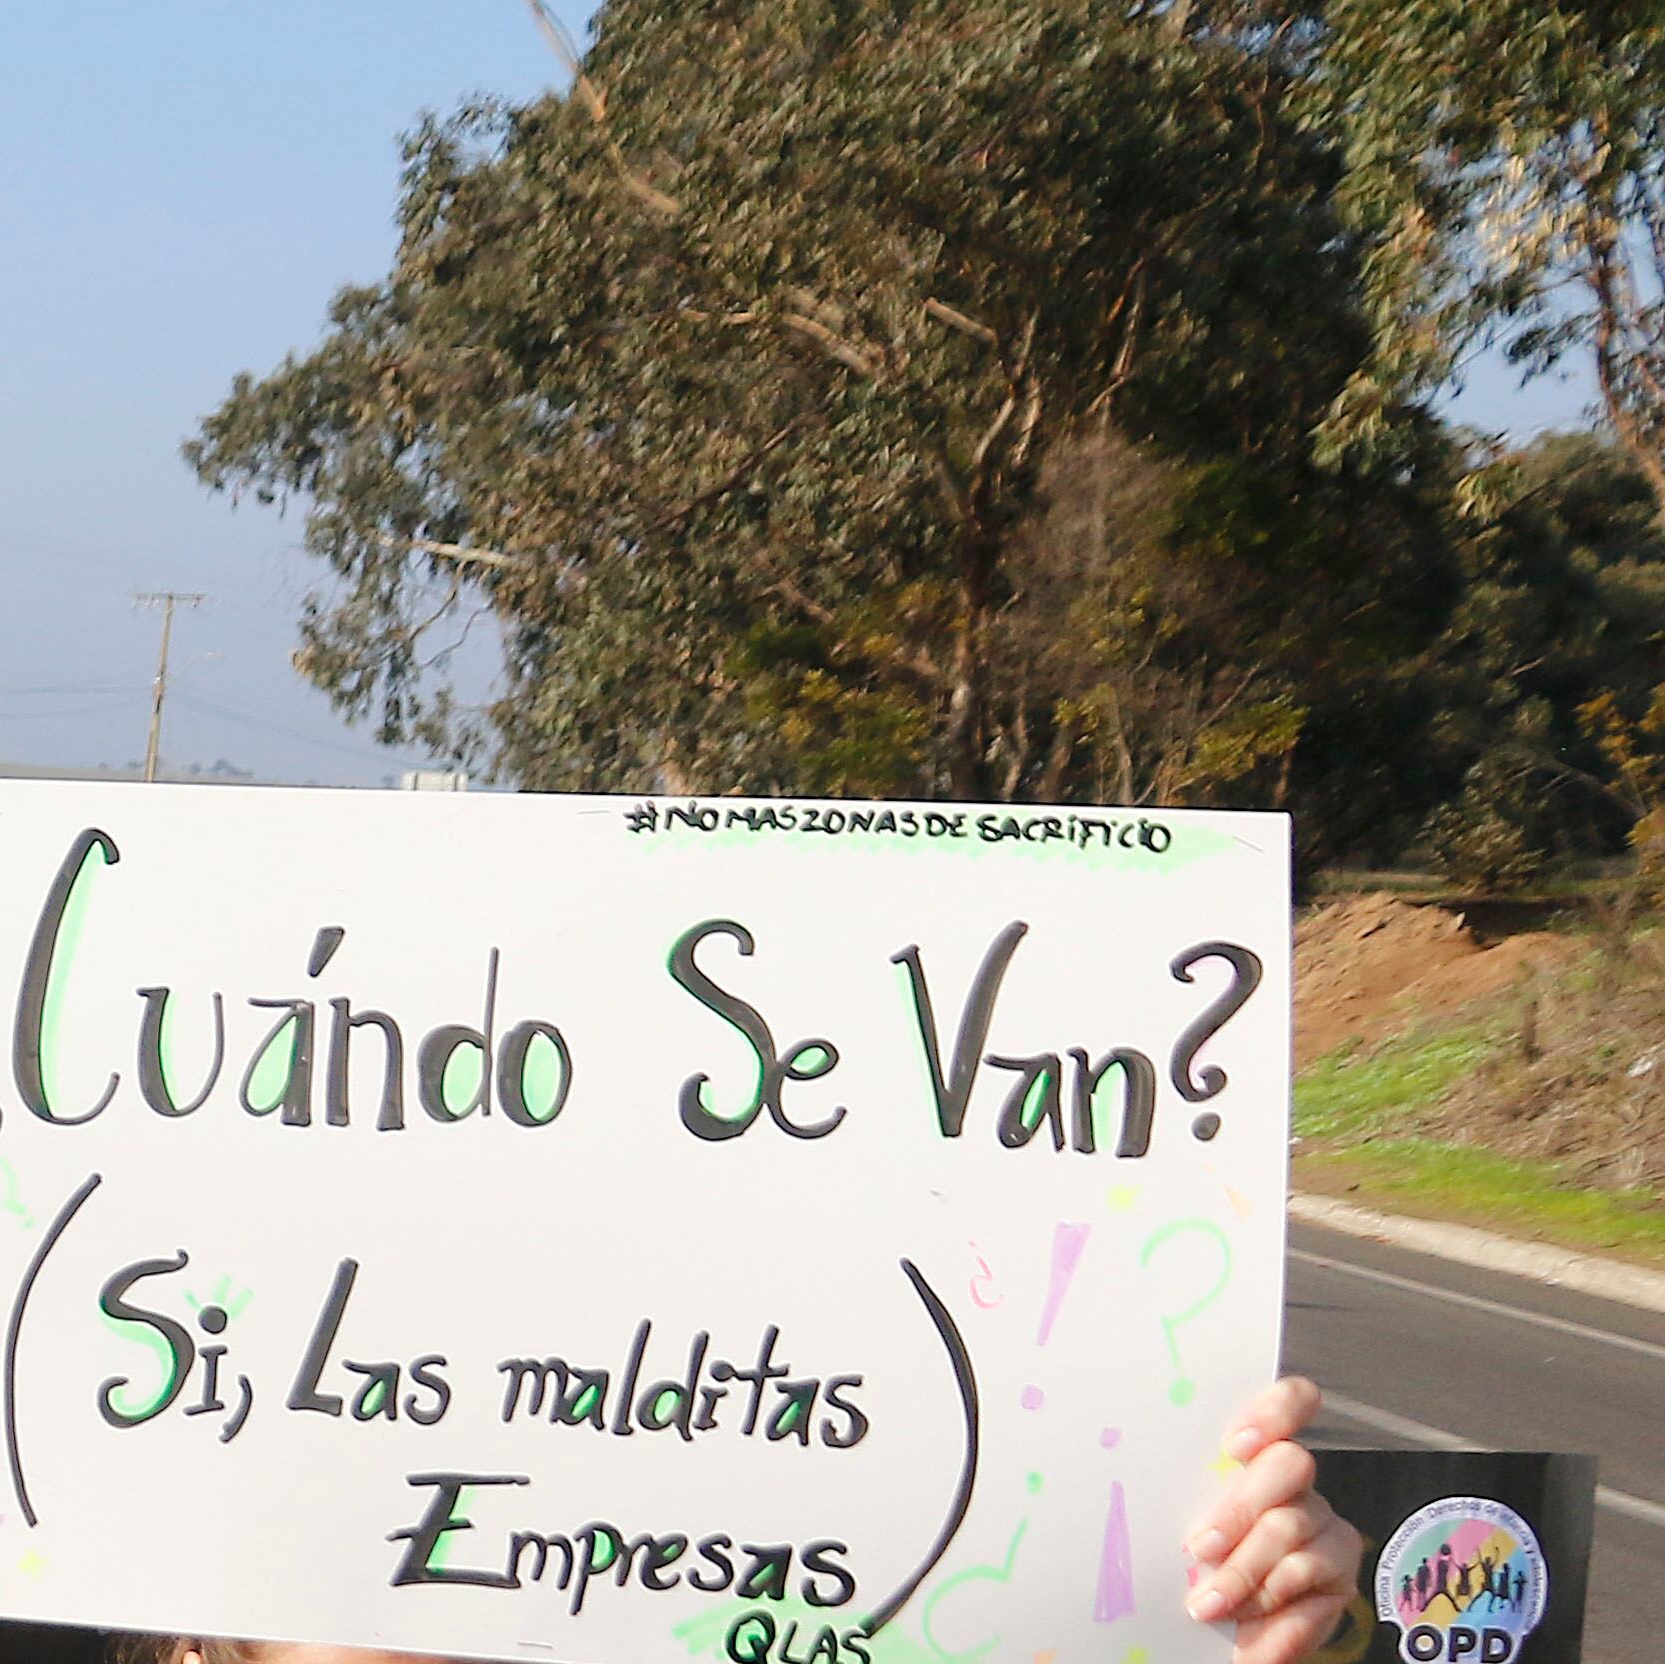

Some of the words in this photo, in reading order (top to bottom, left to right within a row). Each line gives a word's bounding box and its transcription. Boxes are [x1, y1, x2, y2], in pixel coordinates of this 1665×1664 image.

[669, 919, 848, 1142] Se
[892, 921, 1263, 1159] Van?
[288, 1260, 451, 1426] Las
[499, 1320, 869, 1449] malditas
[1406, 1625, 1514, 1664] OPD
